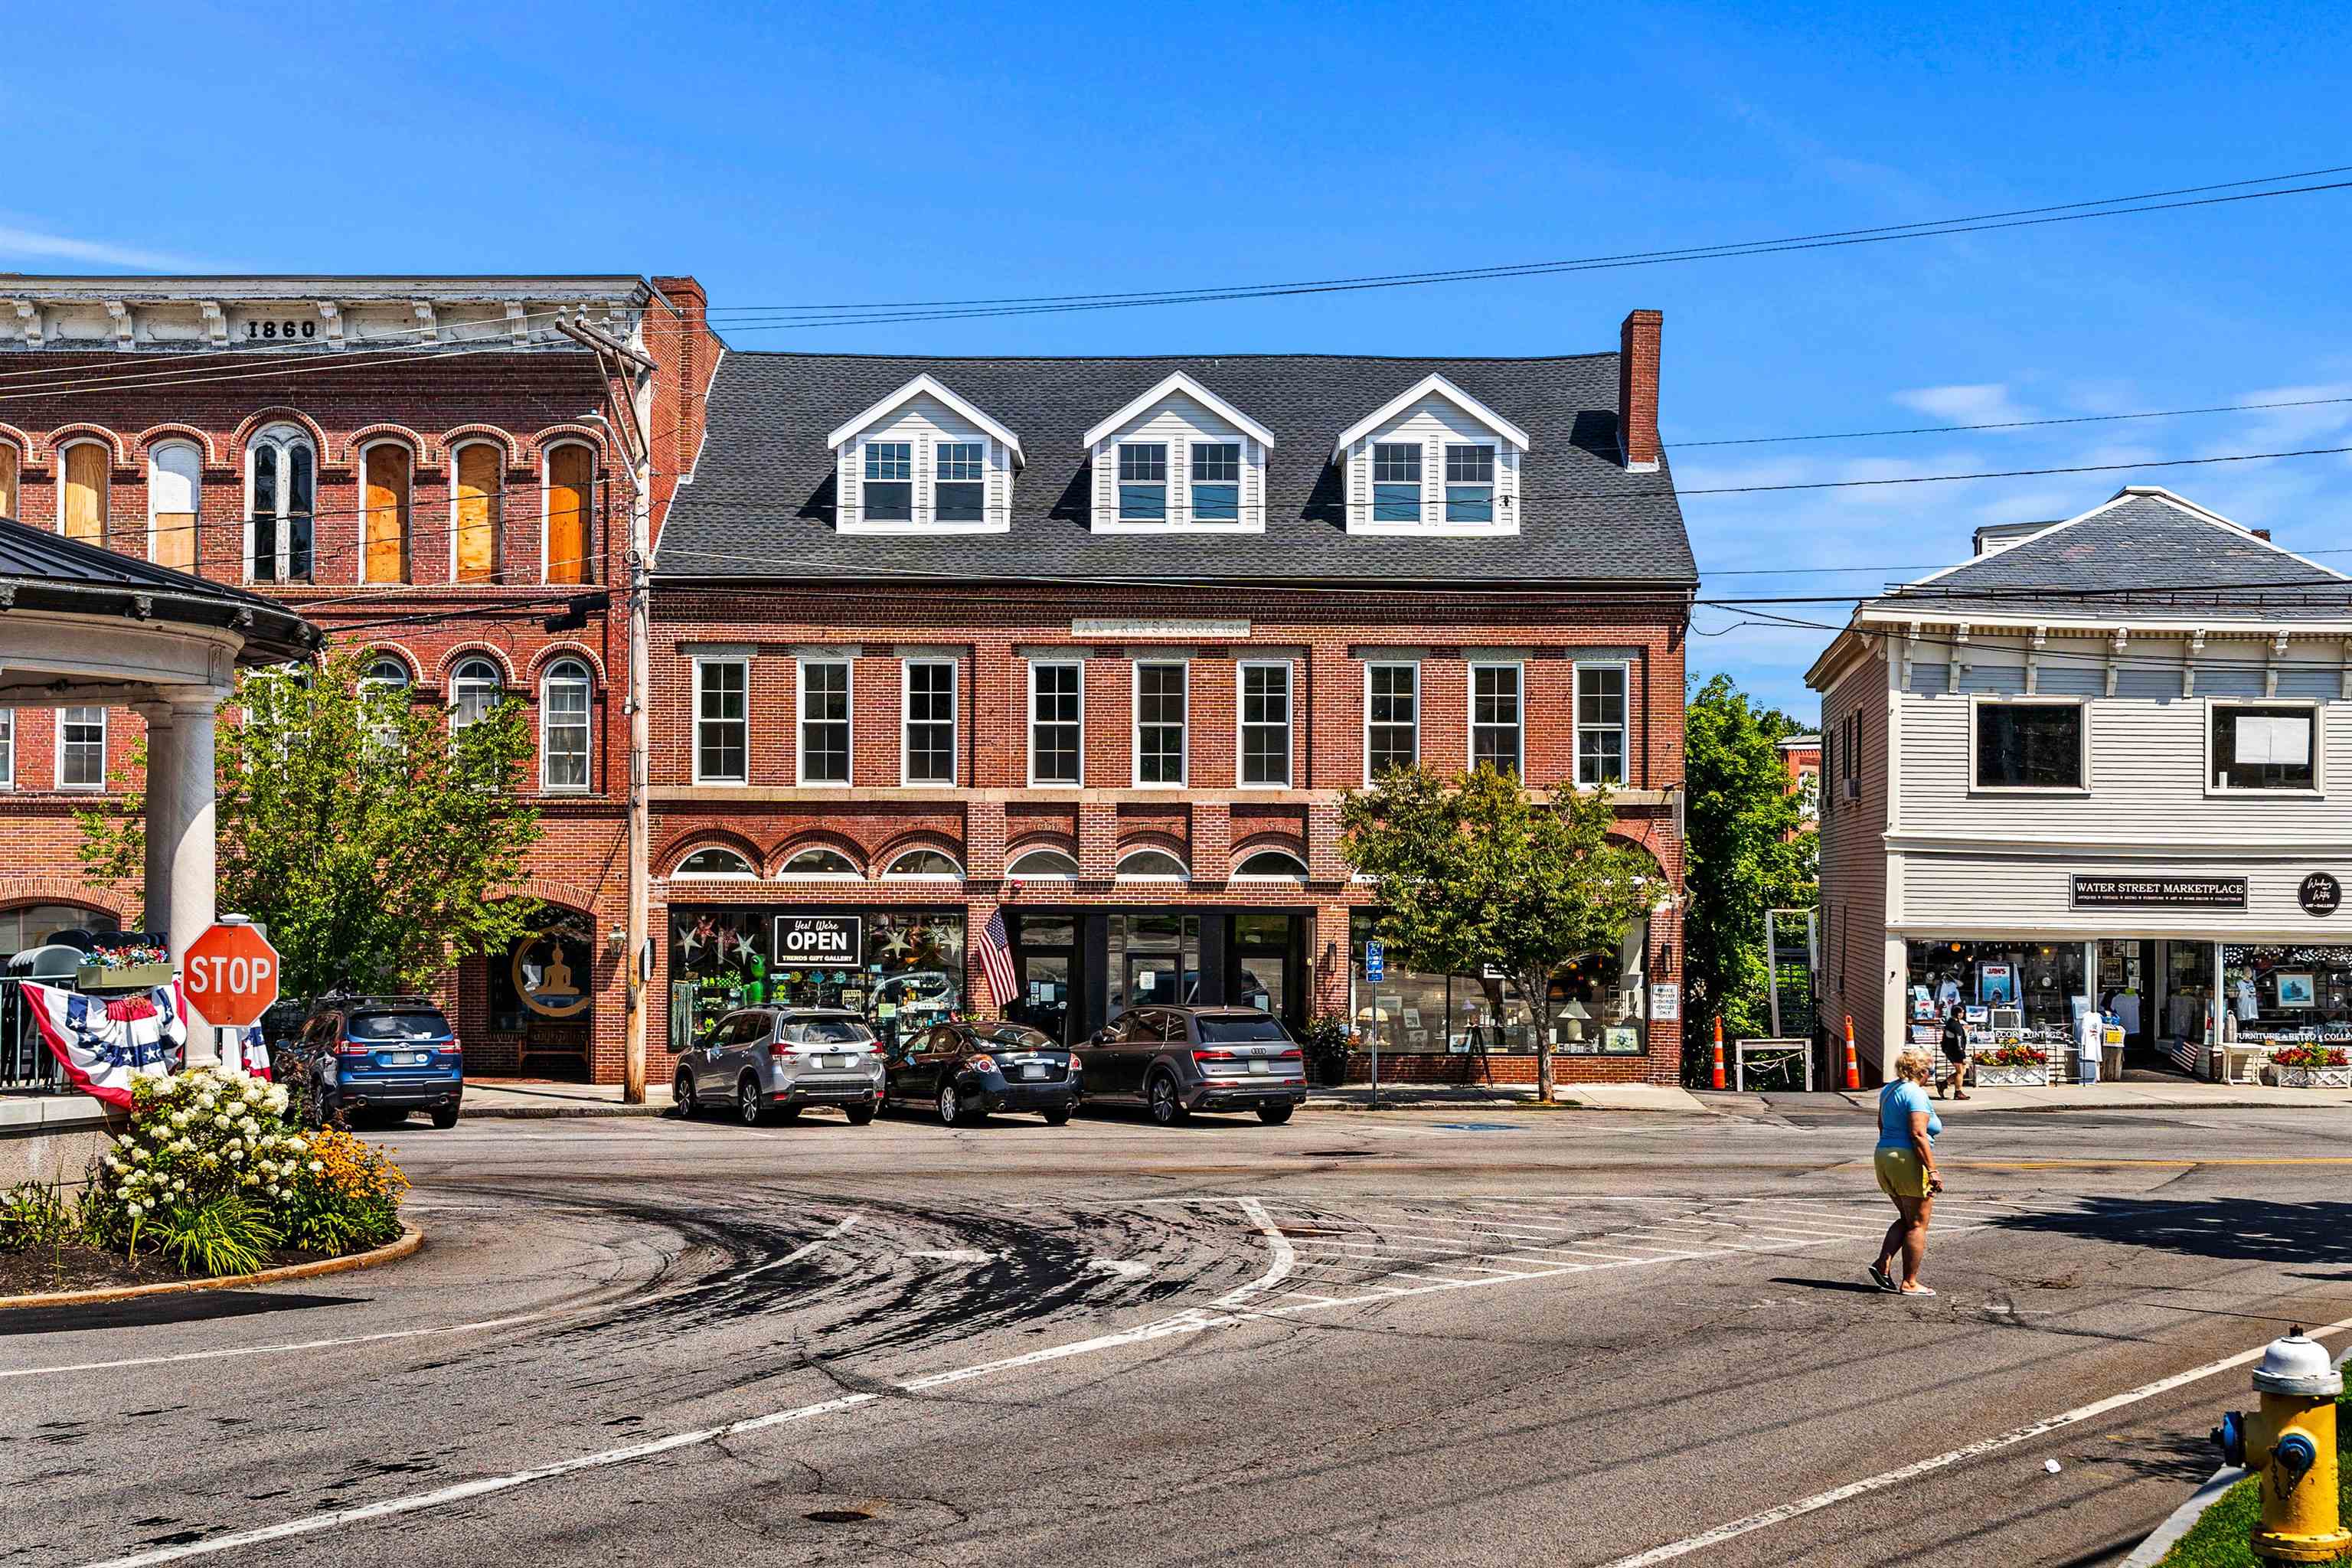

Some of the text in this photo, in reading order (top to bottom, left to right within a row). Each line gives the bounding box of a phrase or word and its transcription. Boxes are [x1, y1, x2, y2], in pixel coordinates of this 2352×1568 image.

[248, 321, 315, 338] 1860
[2076, 883, 2244, 894] WATER STREET MARKETPLACE
[795, 920, 839, 932] Yes! We're
[786, 931, 847, 950] OPEN
[189, 956, 271, 995] STOP
